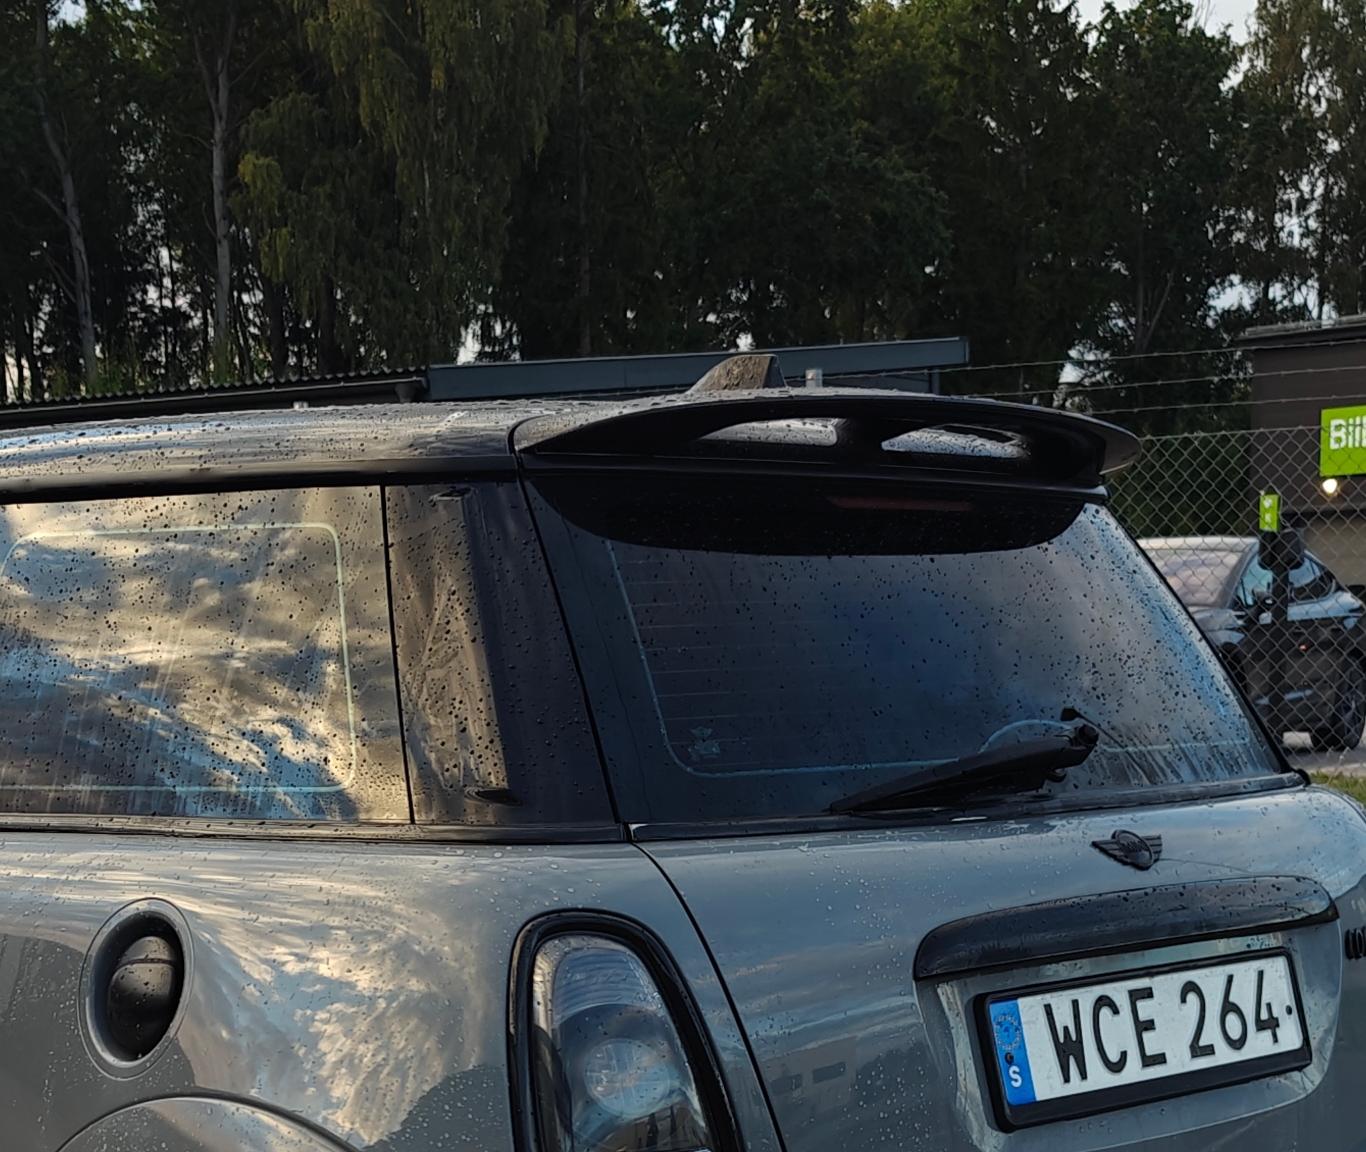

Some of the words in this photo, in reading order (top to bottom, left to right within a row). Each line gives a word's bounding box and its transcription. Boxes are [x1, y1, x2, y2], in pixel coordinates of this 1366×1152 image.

[1044, 987, 1166, 1084] WCE
[1180, 969, 1280, 1058] 264
[1008, 1065, 1022, 1088] S
